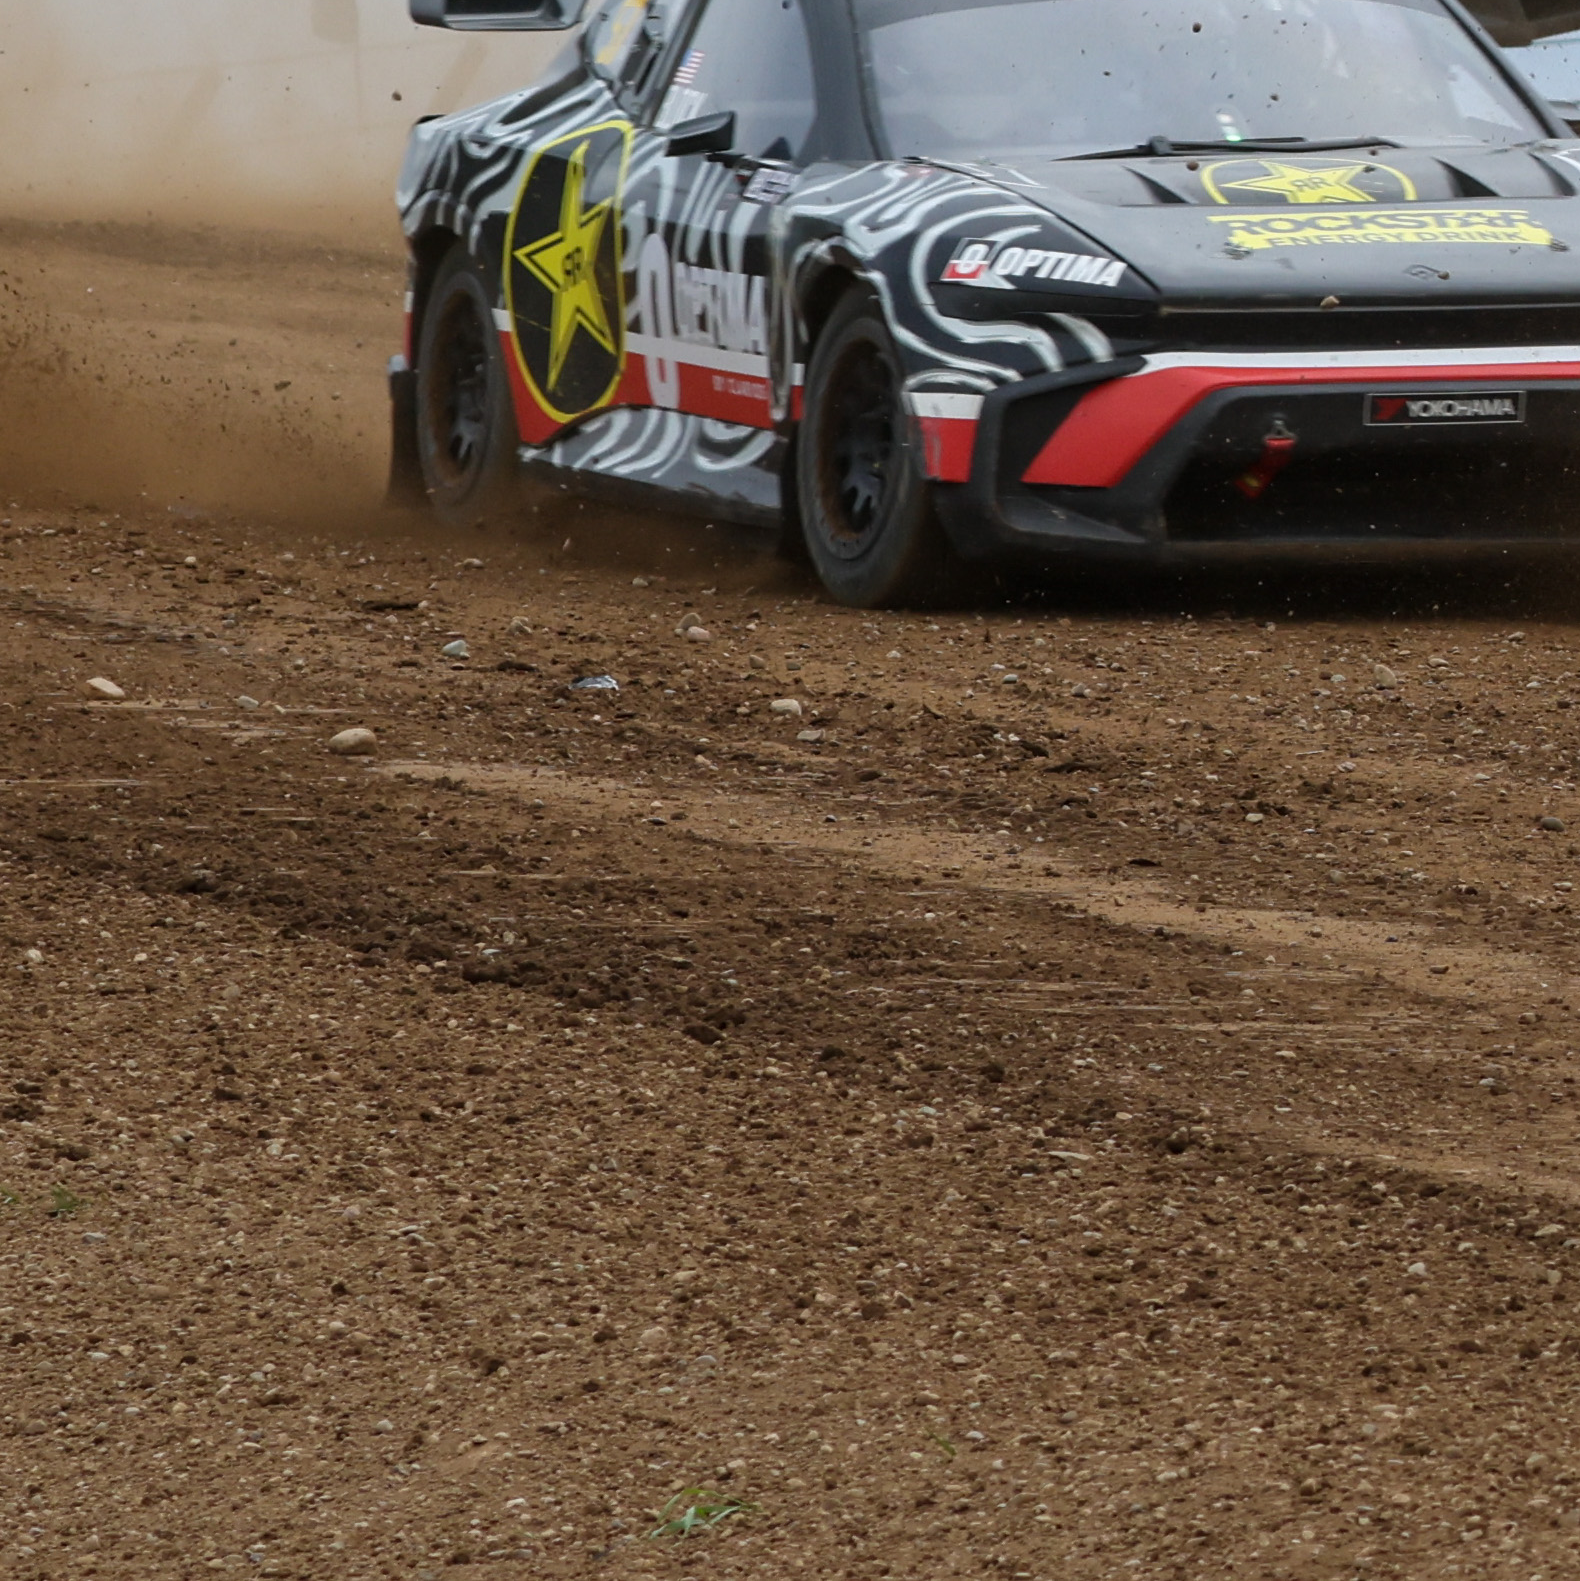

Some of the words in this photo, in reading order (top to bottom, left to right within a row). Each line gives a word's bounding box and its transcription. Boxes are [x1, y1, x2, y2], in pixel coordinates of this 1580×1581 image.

[1268, 231, 1406, 247] ENERGY
[1418, 230, 1530, 243] DRINK
[991, 246, 1129, 287] OPTIMA
[1405, 398, 1517, 418] YOKOHAMA
